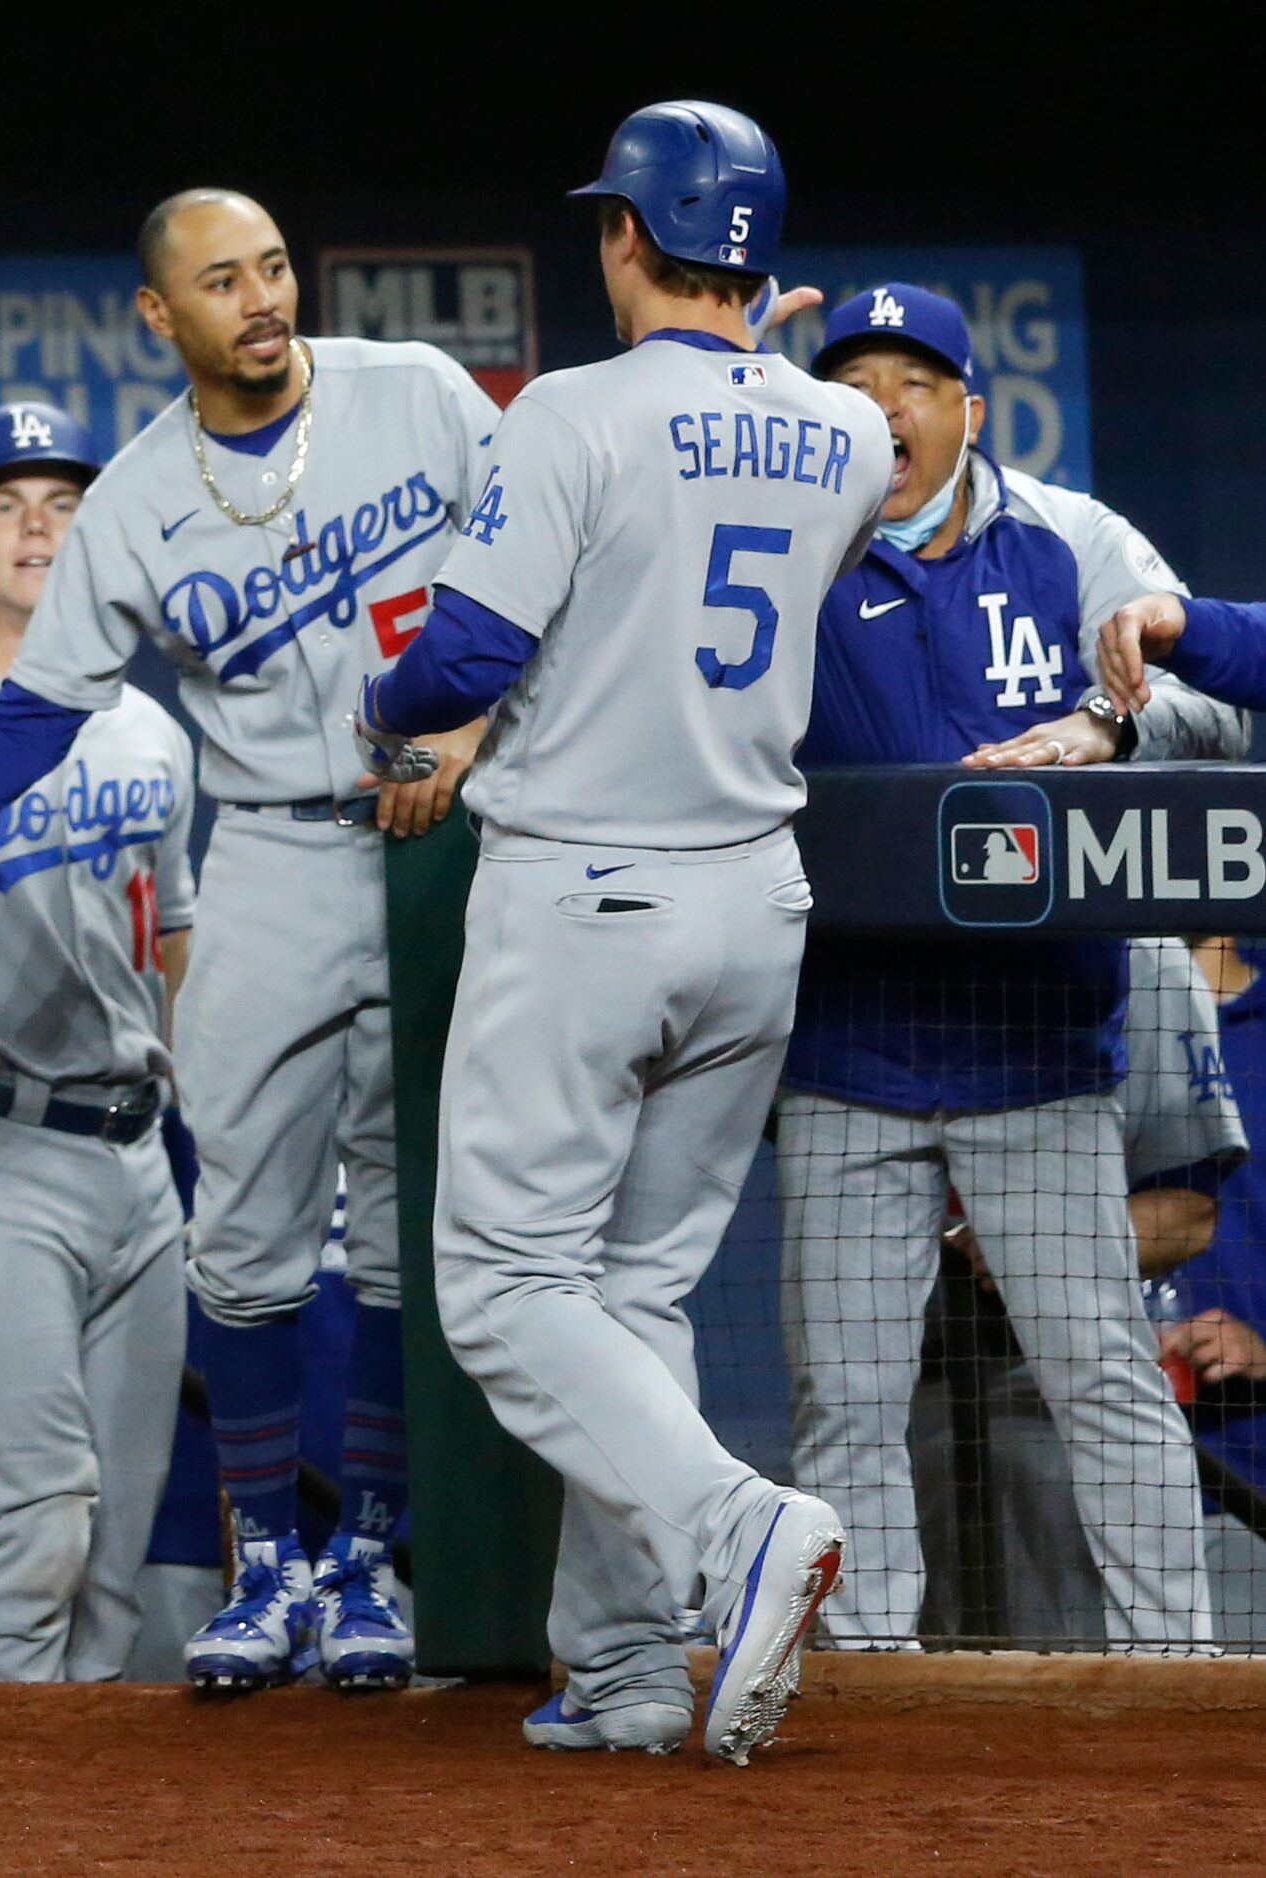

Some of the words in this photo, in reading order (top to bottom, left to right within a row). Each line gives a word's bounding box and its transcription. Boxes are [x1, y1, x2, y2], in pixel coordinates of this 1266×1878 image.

[729, 205, 753, 243] 5
[336, 266, 518, 342] MLB
[868, 288, 905, 328] LA
[10, 406, 54, 449] LA
[669, 412, 852, 494] SEAGER
[161, 471, 444, 661] Dodgers
[695, 523, 792, 690] 5
[977, 592, 1064, 708] LA
[1066, 808, 1266, 901] MLB
